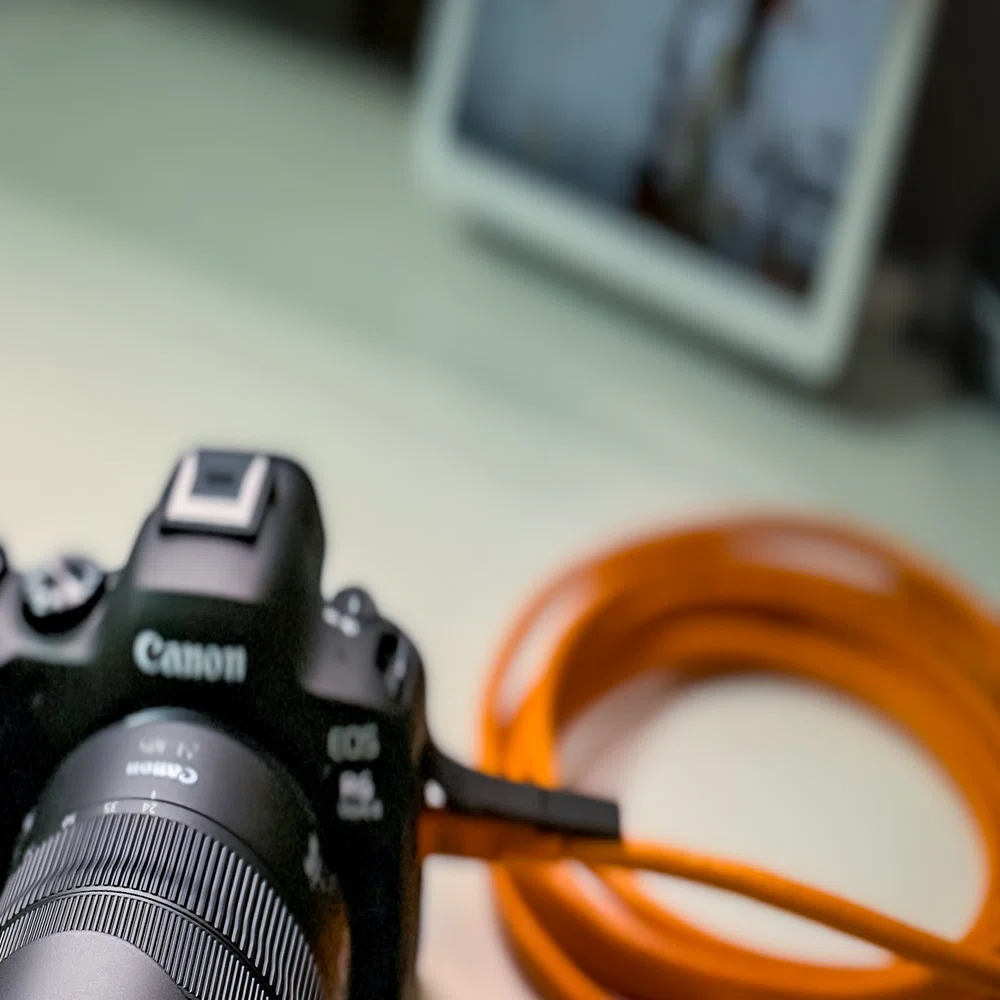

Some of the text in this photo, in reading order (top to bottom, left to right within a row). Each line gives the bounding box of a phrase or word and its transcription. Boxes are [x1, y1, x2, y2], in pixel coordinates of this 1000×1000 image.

[133, 629, 247, 682] Canon
[126, 760, 199, 785] Canon
[103, 801, 159, 814] 24 35
